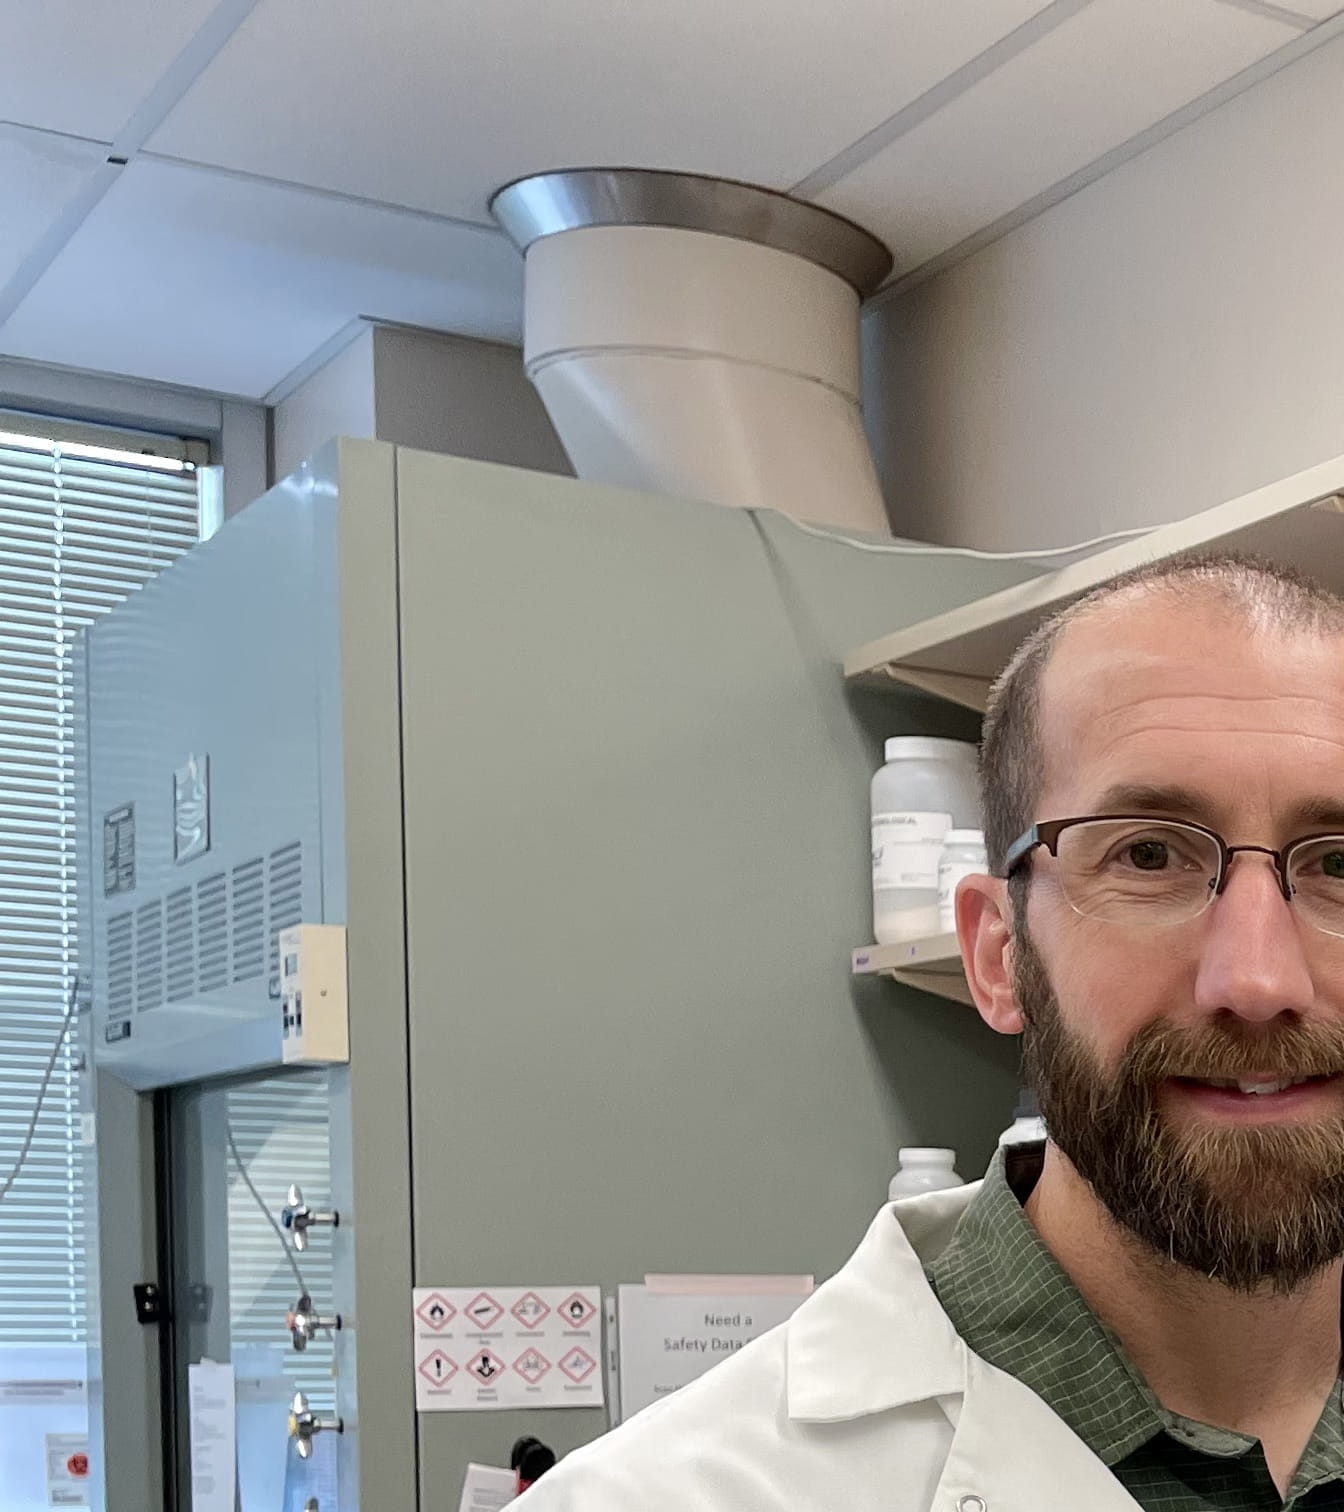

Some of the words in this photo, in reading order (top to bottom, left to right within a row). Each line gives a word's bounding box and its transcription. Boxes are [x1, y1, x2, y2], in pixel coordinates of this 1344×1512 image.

[704, 1313, 741, 1327] Need
[745, 1316, 753, 1326] a
[664, 1337, 707, 1353] Safety
[711, 1338, 743, 1351] Data
